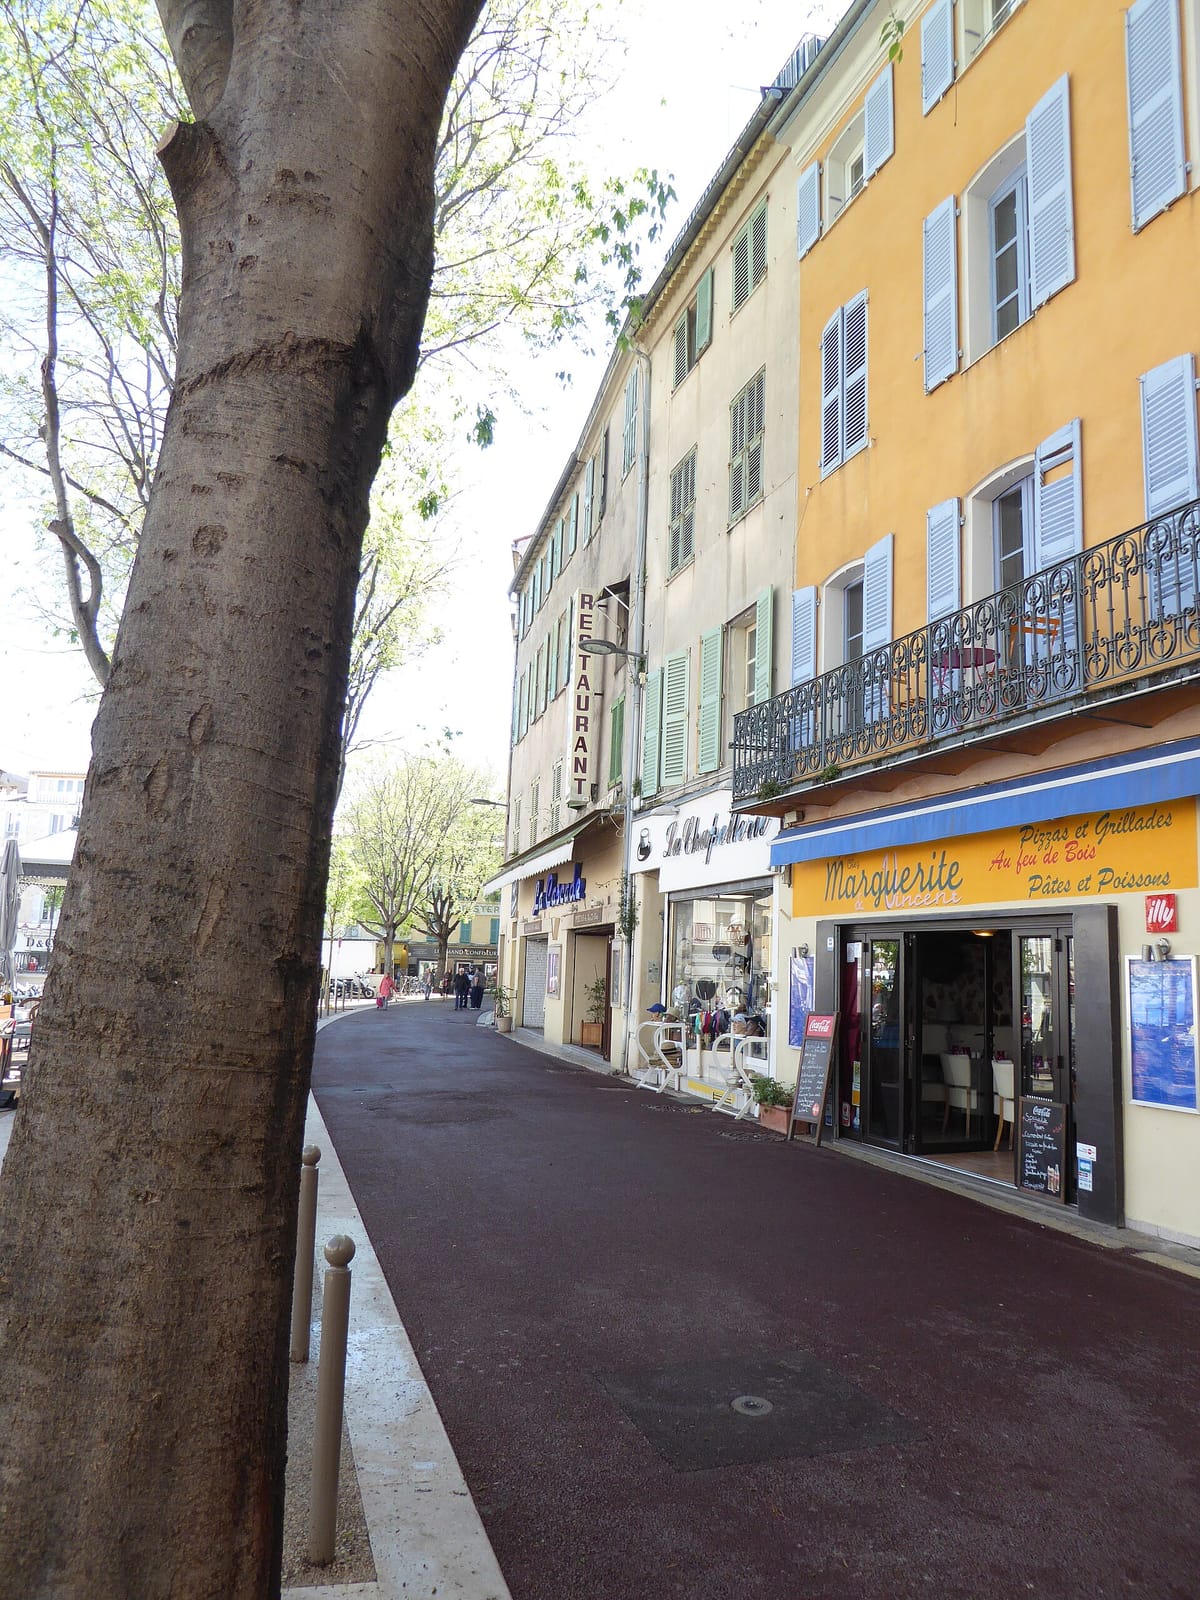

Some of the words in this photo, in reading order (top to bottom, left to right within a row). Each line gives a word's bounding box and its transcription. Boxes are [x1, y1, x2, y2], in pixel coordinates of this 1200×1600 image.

[1019, 824, 1070, 851] Pizzas
[1074, 820, 1090, 838] et
[1094, 808, 1173, 845] Grillades
[988, 848, 1012, 872] Au
[1015, 848, 1037, 875] feu
[1043, 845, 1059, 865] de
[1064, 840, 1097, 863] Bois
[825, 850, 963, 909] Marguerite
[1027, 874, 1071, 898] Pâtes
[1077, 874, 1092, 893] et
[1097, 866, 1171, 893] Poissons
[1147, 898, 1175, 929] illy
